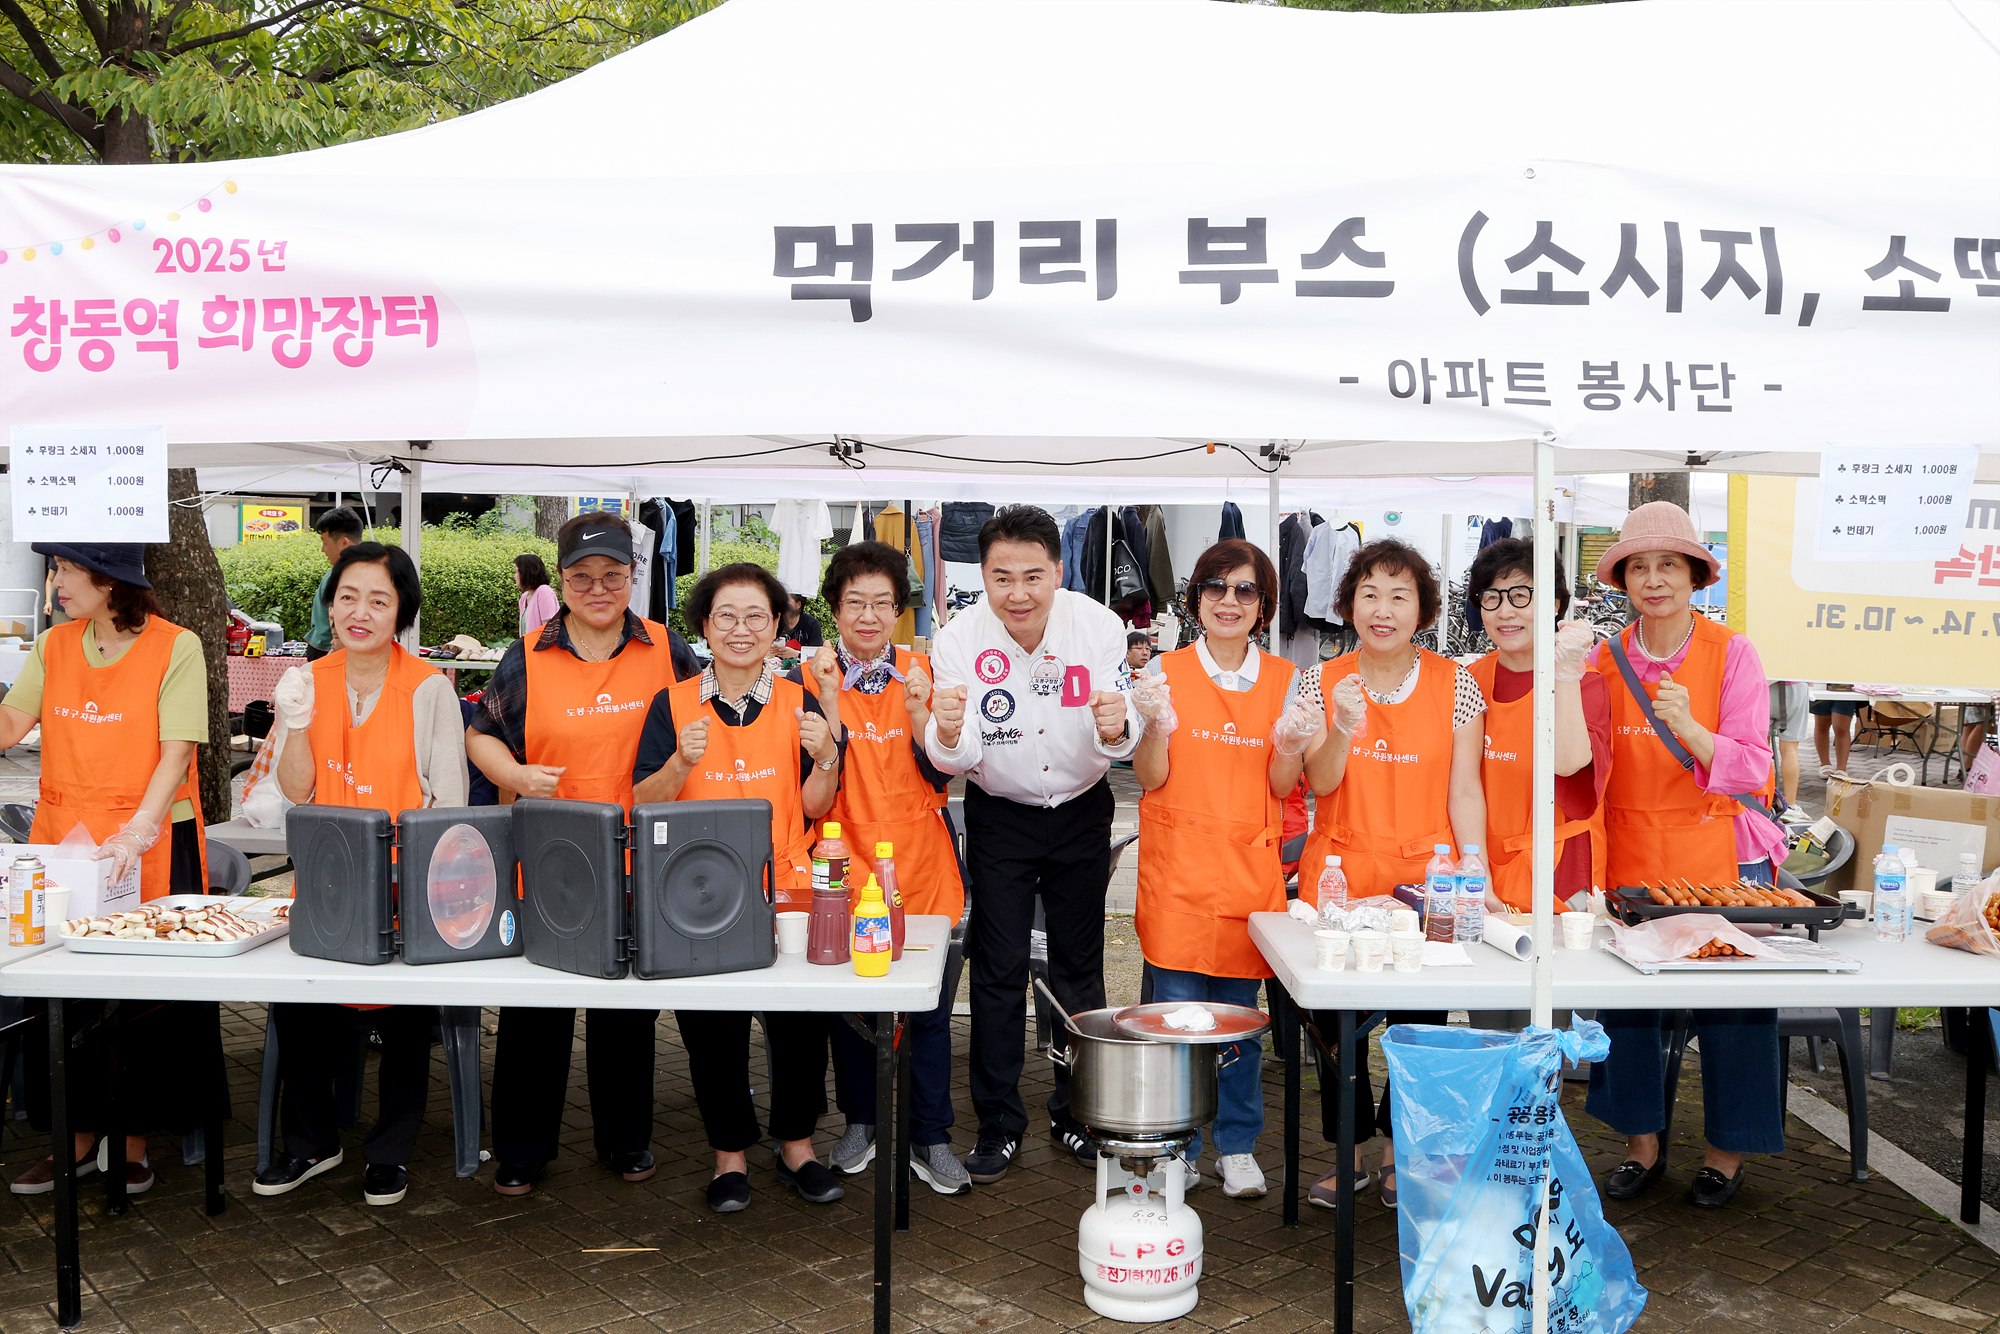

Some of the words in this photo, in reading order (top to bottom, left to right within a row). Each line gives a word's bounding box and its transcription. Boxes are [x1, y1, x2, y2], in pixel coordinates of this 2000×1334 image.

[153, 237, 287, 273] 2025년
[773, 218, 1117, 323] 먹거리
[1178, 217, 1396, 305] 부스
[1457, 210, 1821, 327] (소시지,
[11, 295, 179, 373] 창동역
[198, 294, 440, 370] 희망장터
[1387, 357, 1553, 407] 아파트
[1577, 360, 1738, 413] 봉사단
[39, 445, 65, 456] 후랑크
[70, 445, 97, 456] 소세지
[1851, 463, 1880, 474] 후랑크
[1884, 463, 1913, 475] 소세지
[41, 506, 68, 516] 번데기
[1846, 525, 1874, 536] 번데기
